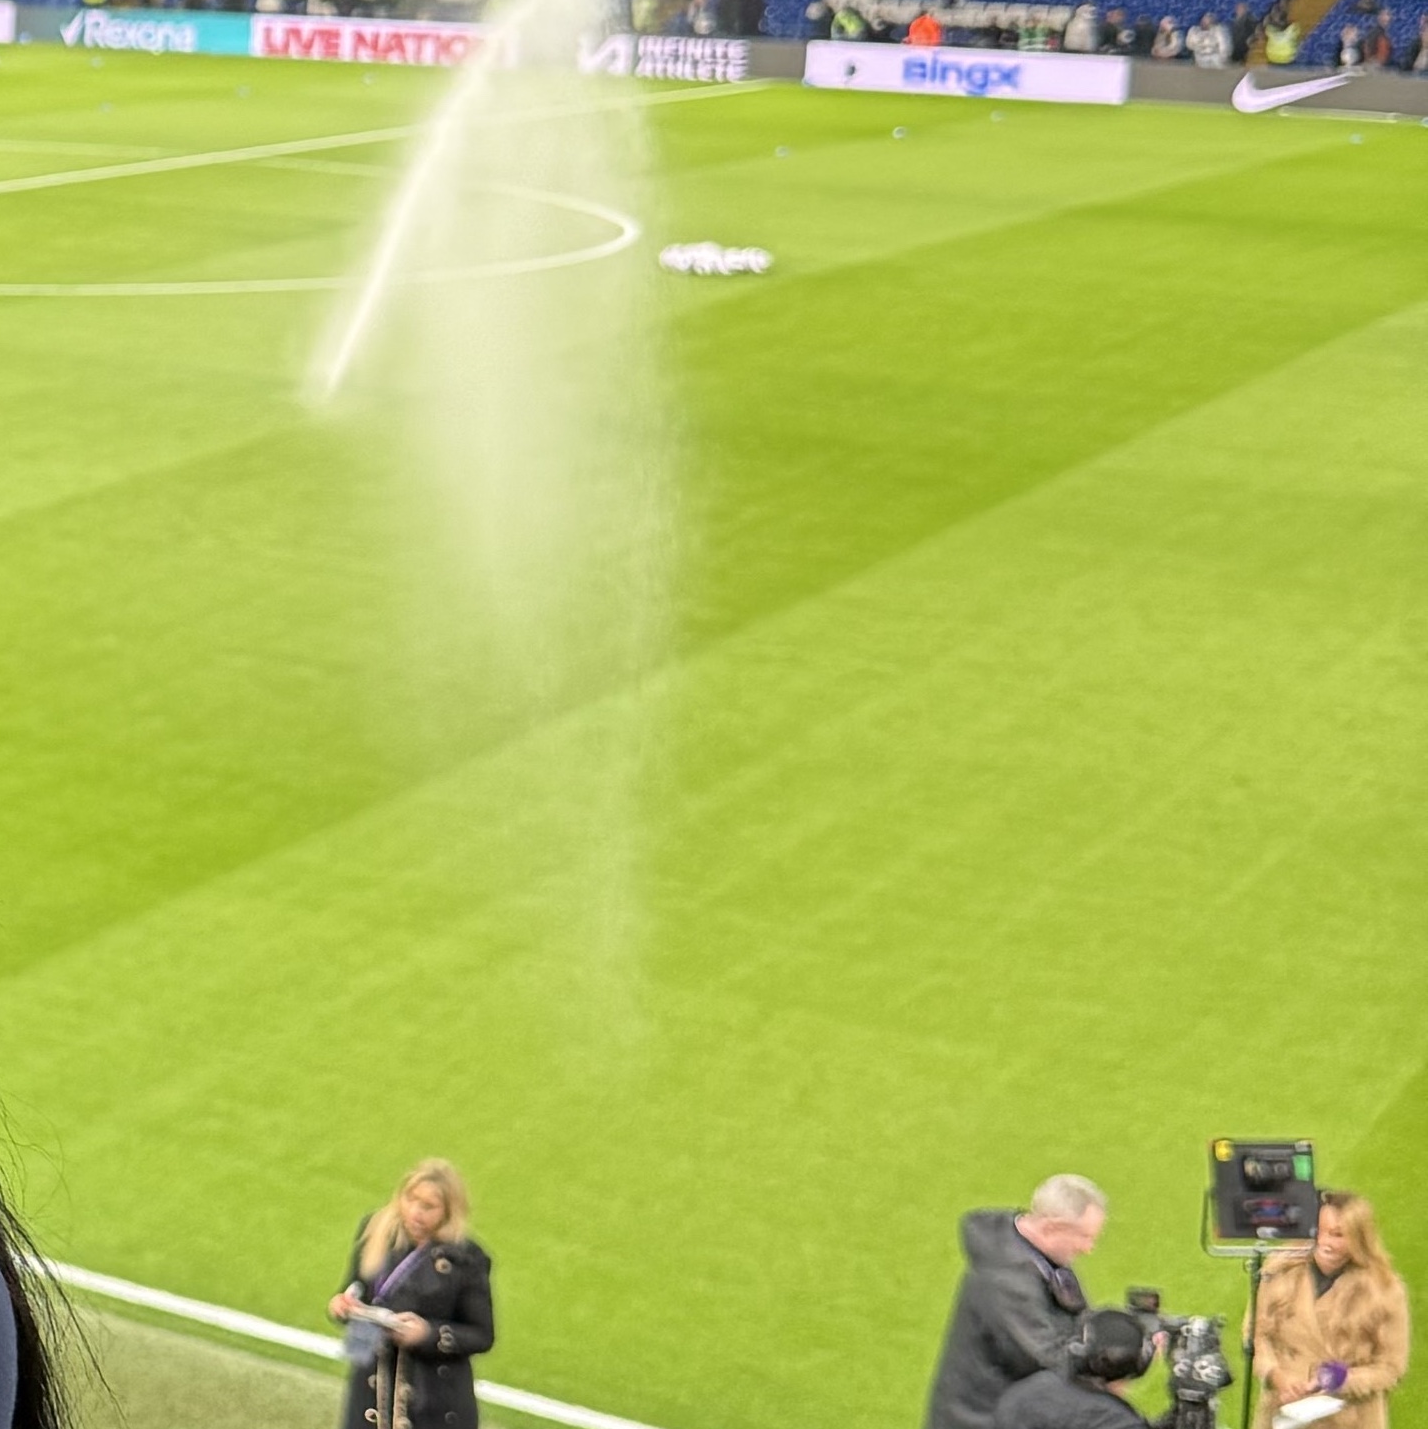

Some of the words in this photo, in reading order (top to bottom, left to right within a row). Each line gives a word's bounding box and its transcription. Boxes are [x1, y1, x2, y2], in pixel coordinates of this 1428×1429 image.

[84, 11, 197, 53] Rexona
[262, 27, 342, 58] LIVE
[351, 30, 491, 66] NATIO
